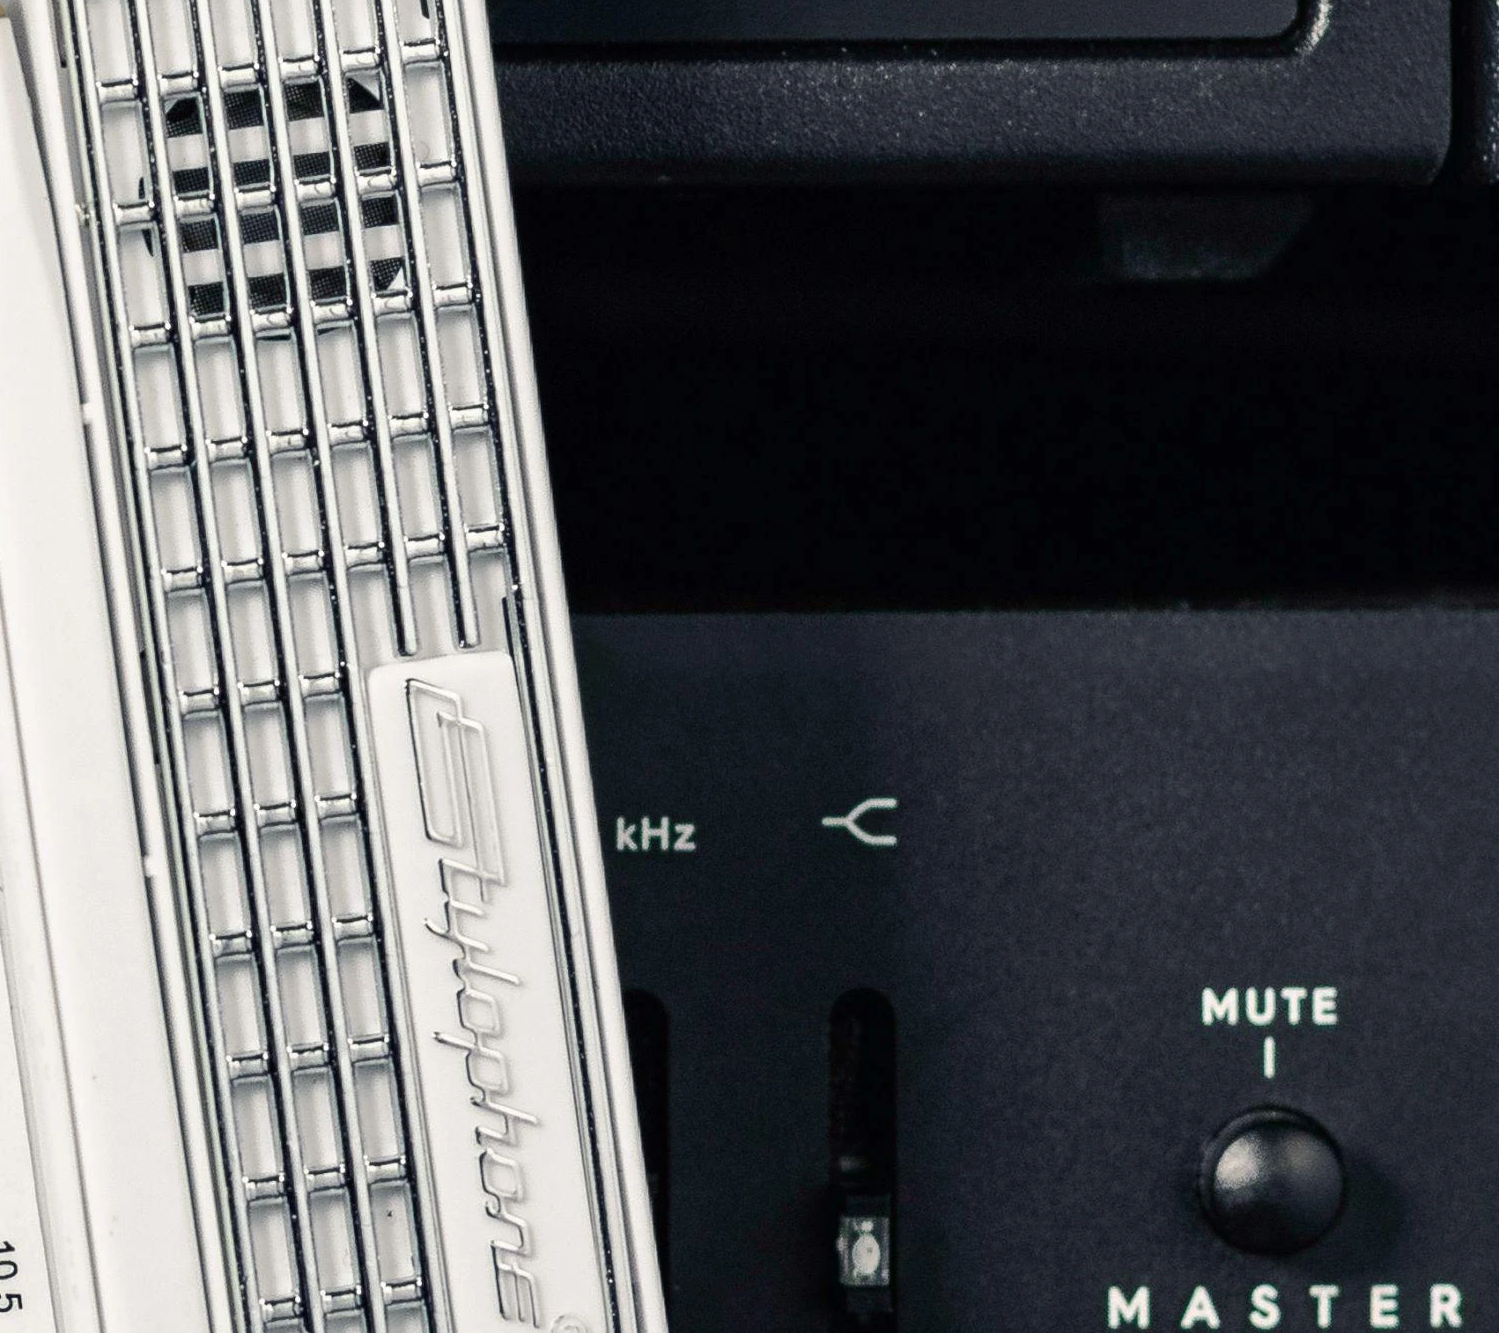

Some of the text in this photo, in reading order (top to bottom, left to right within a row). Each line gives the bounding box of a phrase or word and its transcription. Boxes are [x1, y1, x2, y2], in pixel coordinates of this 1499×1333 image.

[616, 816, 696, 851] kHz
[405, 677, 541, 1330] Stylophone
[1202, 987, 1337, 1026] MUTE
[1108, 1283, 1462, 1330] MASTER
